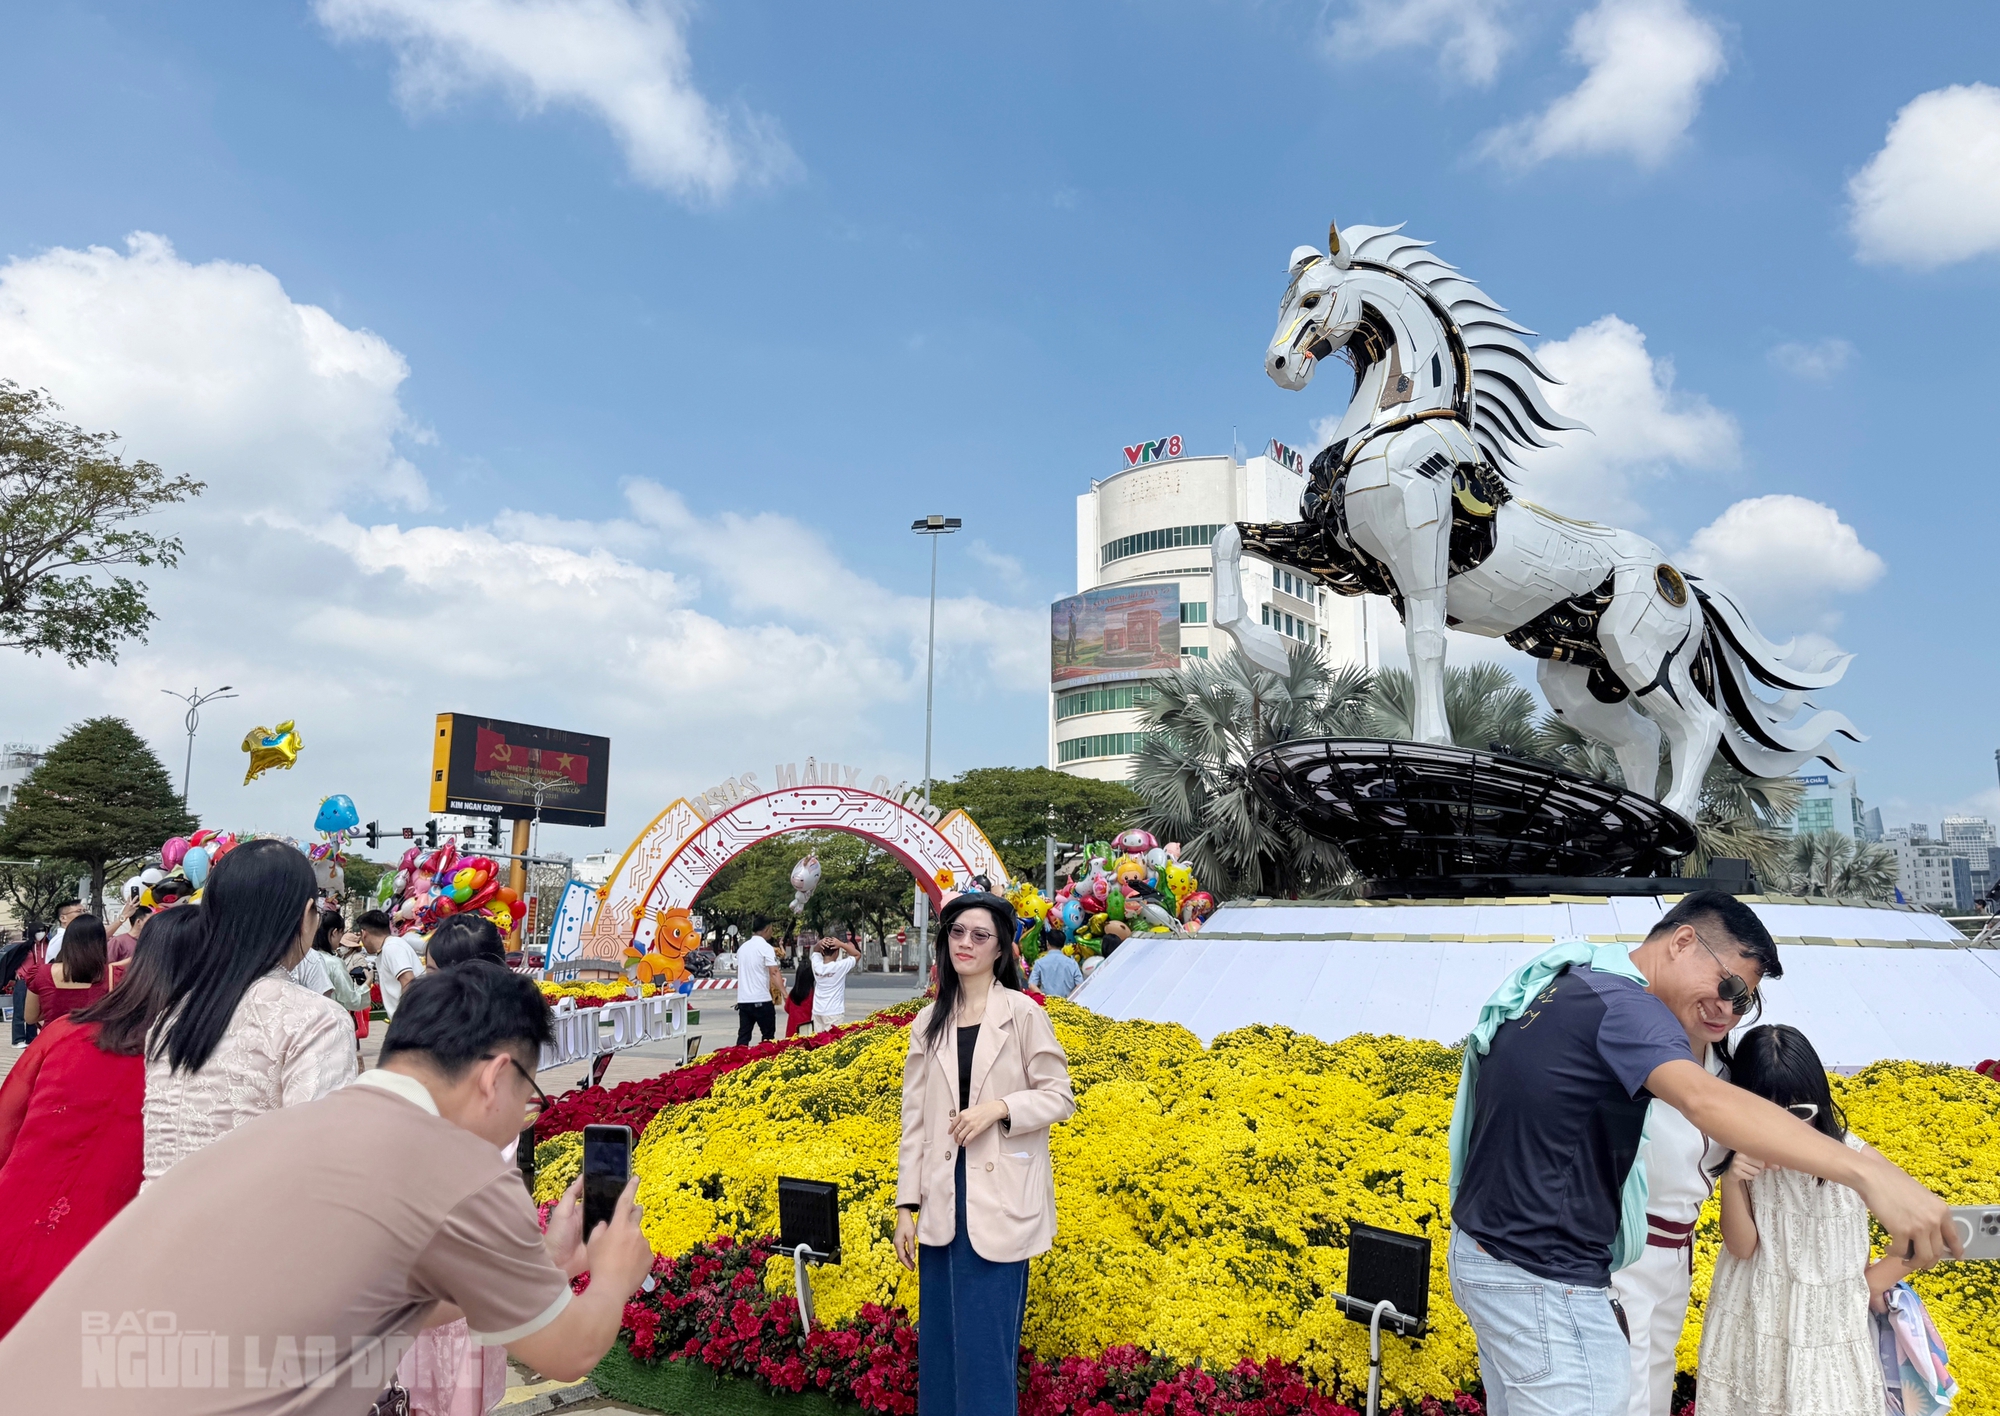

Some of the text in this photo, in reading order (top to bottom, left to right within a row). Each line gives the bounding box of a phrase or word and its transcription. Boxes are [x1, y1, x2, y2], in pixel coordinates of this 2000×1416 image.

[450, 800, 503, 813] KIM NGAN GROUP
